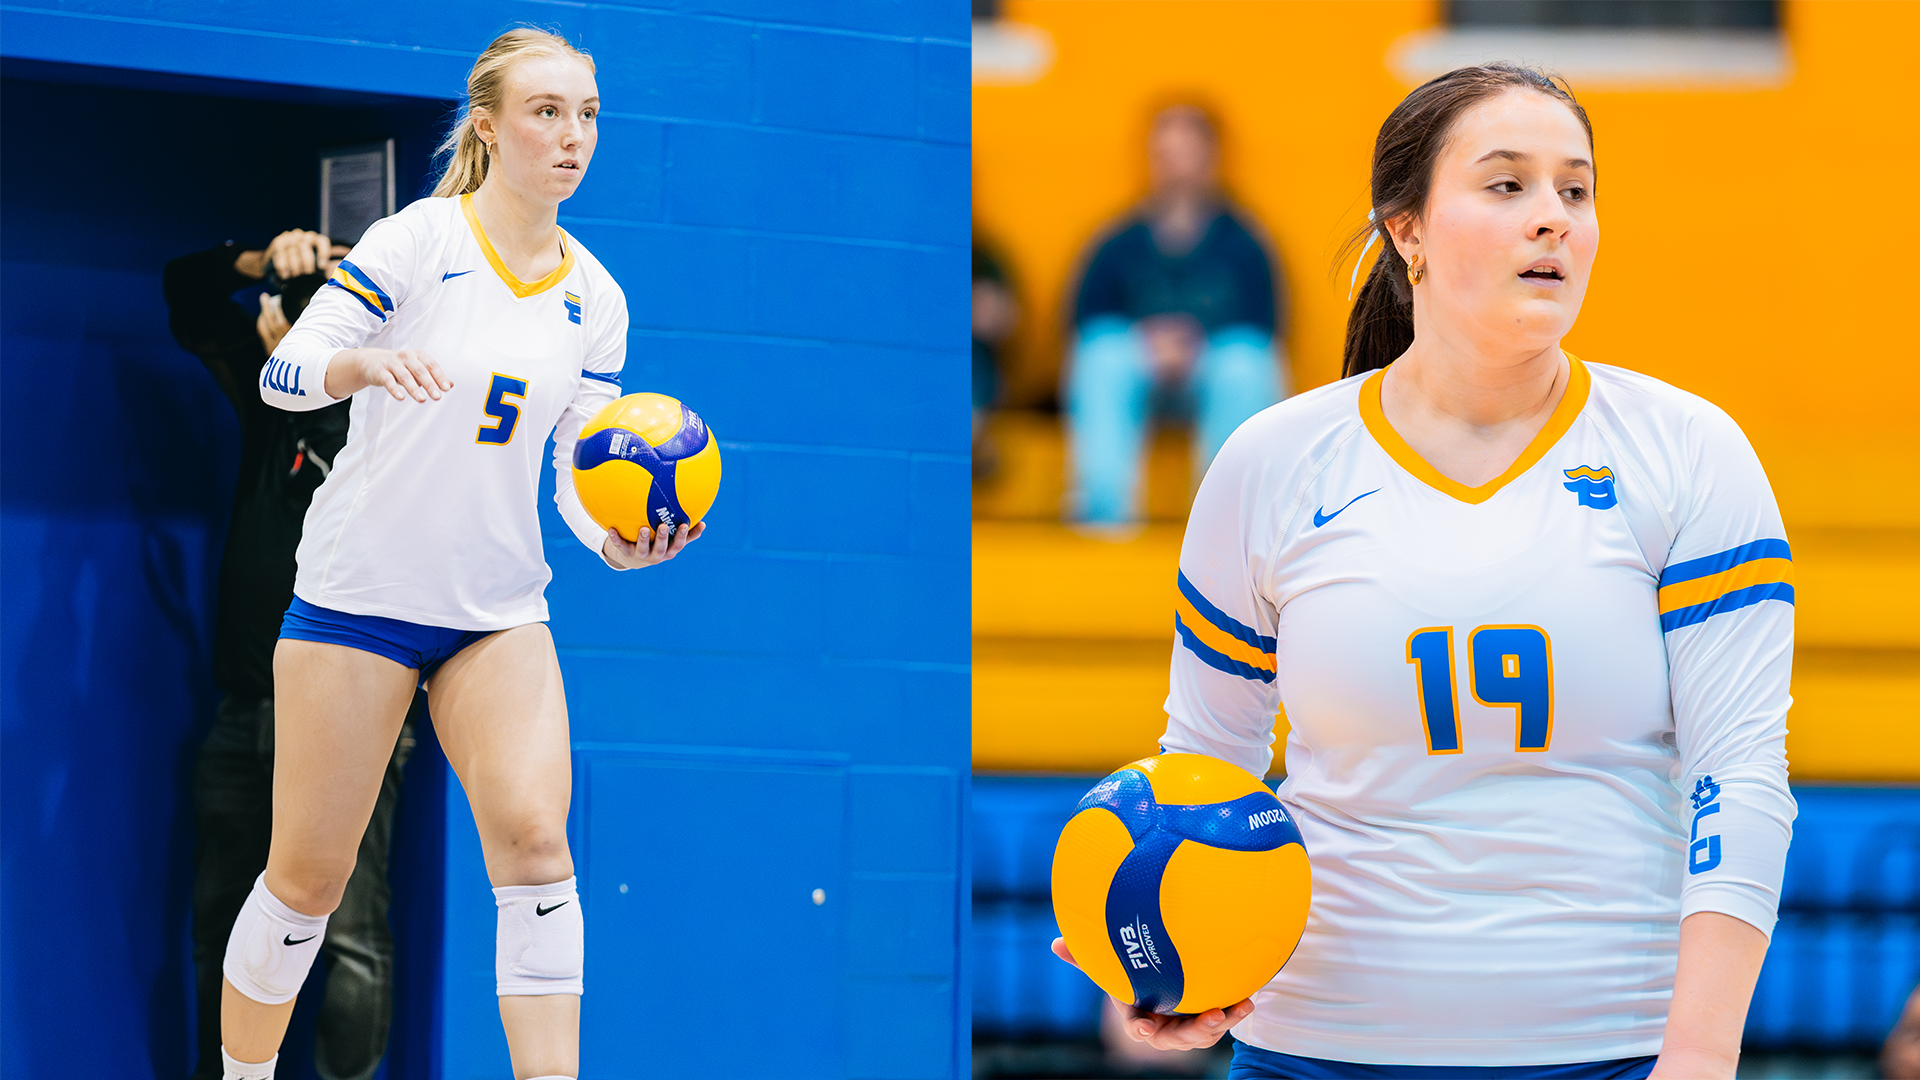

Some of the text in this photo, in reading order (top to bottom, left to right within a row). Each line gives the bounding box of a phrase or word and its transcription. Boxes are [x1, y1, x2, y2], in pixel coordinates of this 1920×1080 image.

[475, 372, 529, 446] 5
[656, 506, 678, 536] MIKAS
[1405, 624, 1554, 756] 19
[1248, 808, 1289, 831] V200W
[1120, 923, 1148, 970] FIVB
[1141, 923, 1162, 965] APPROVED
